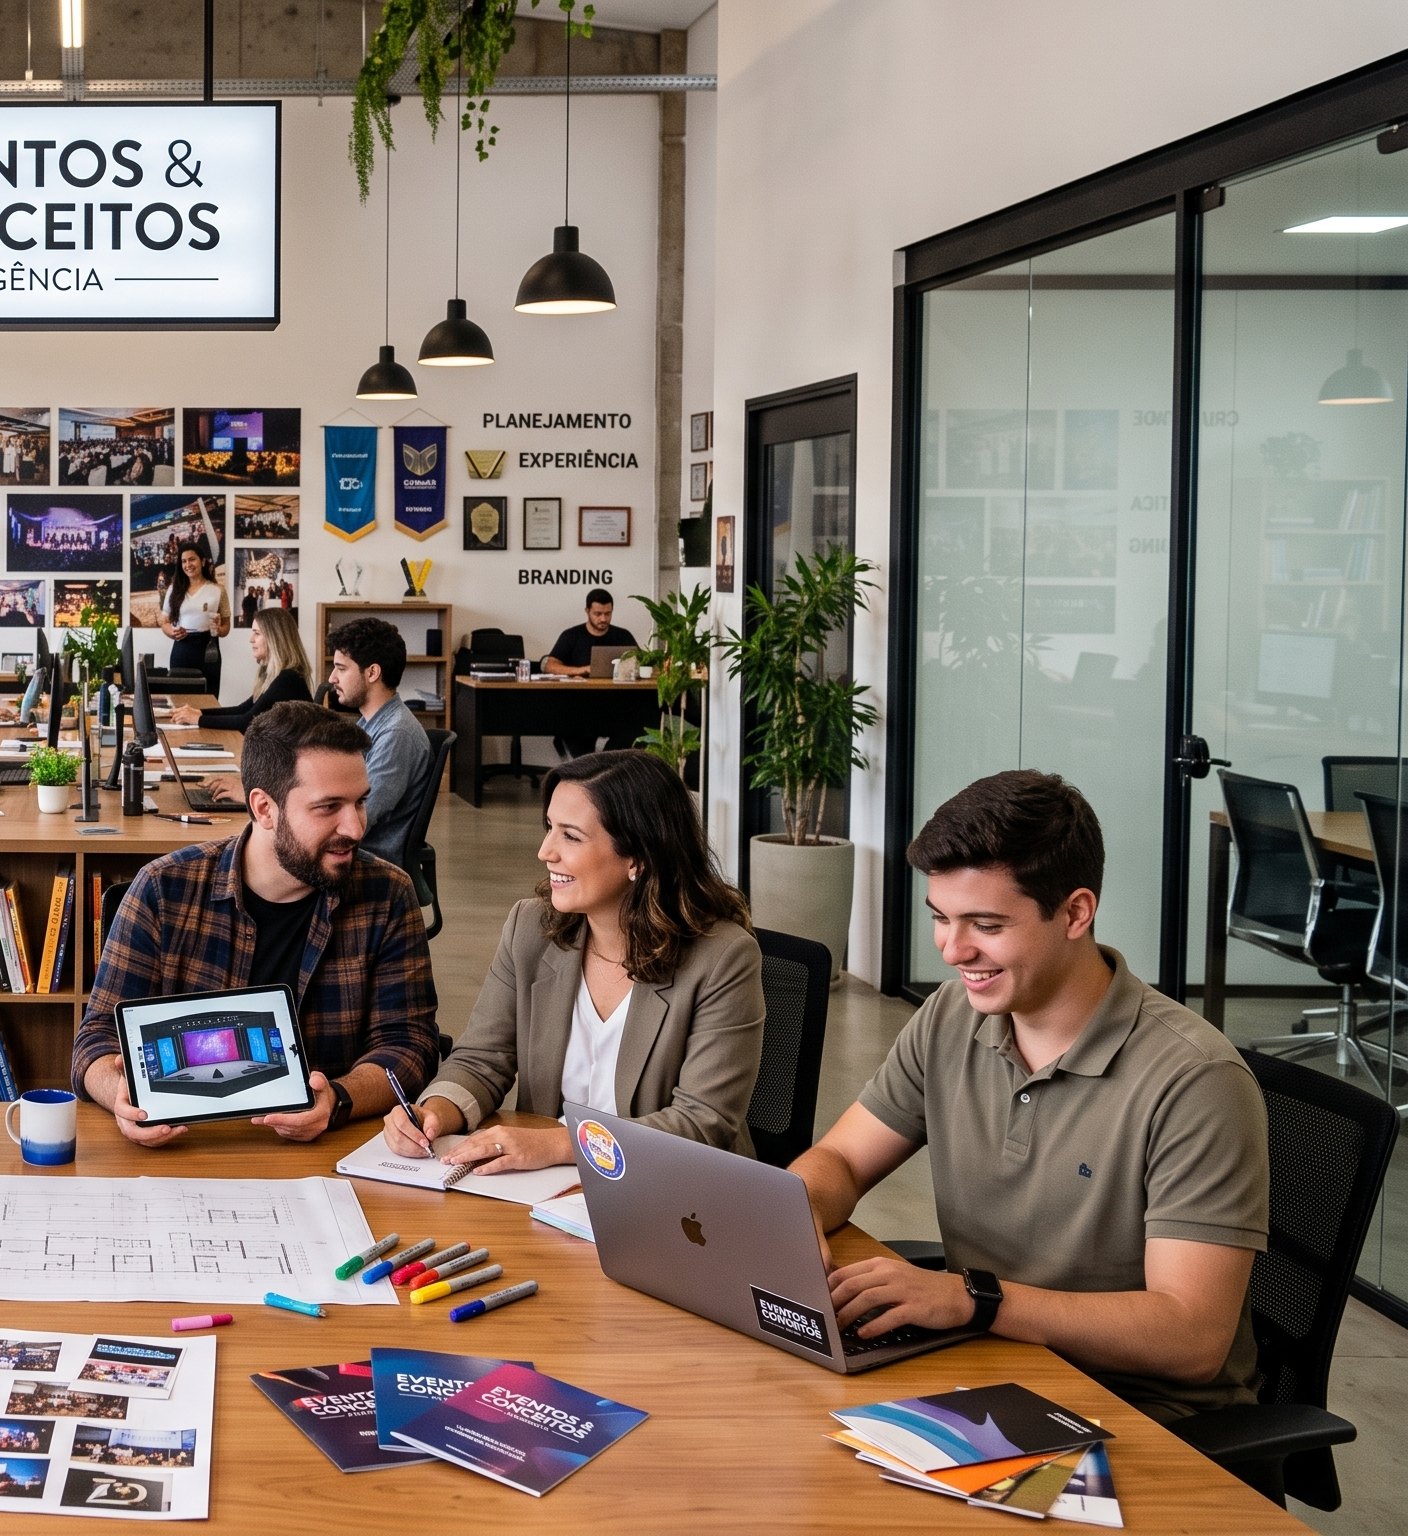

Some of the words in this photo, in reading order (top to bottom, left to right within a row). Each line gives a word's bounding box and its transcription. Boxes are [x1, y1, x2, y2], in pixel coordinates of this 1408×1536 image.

[164, 139, 203, 188] &
[482, 413, 632, 430] PLANEJAMENTO
[519, 448, 639, 469] EXPERIÊNCIA
[518, 569, 613, 586] BRANDING
[759, 1298, 808, 1325] EVENTOS
[396, 1383, 464, 1397] CONC
[481, 1393, 589, 1439] CONCEITOS
[490, 1386, 580, 1425] EVENTOS
